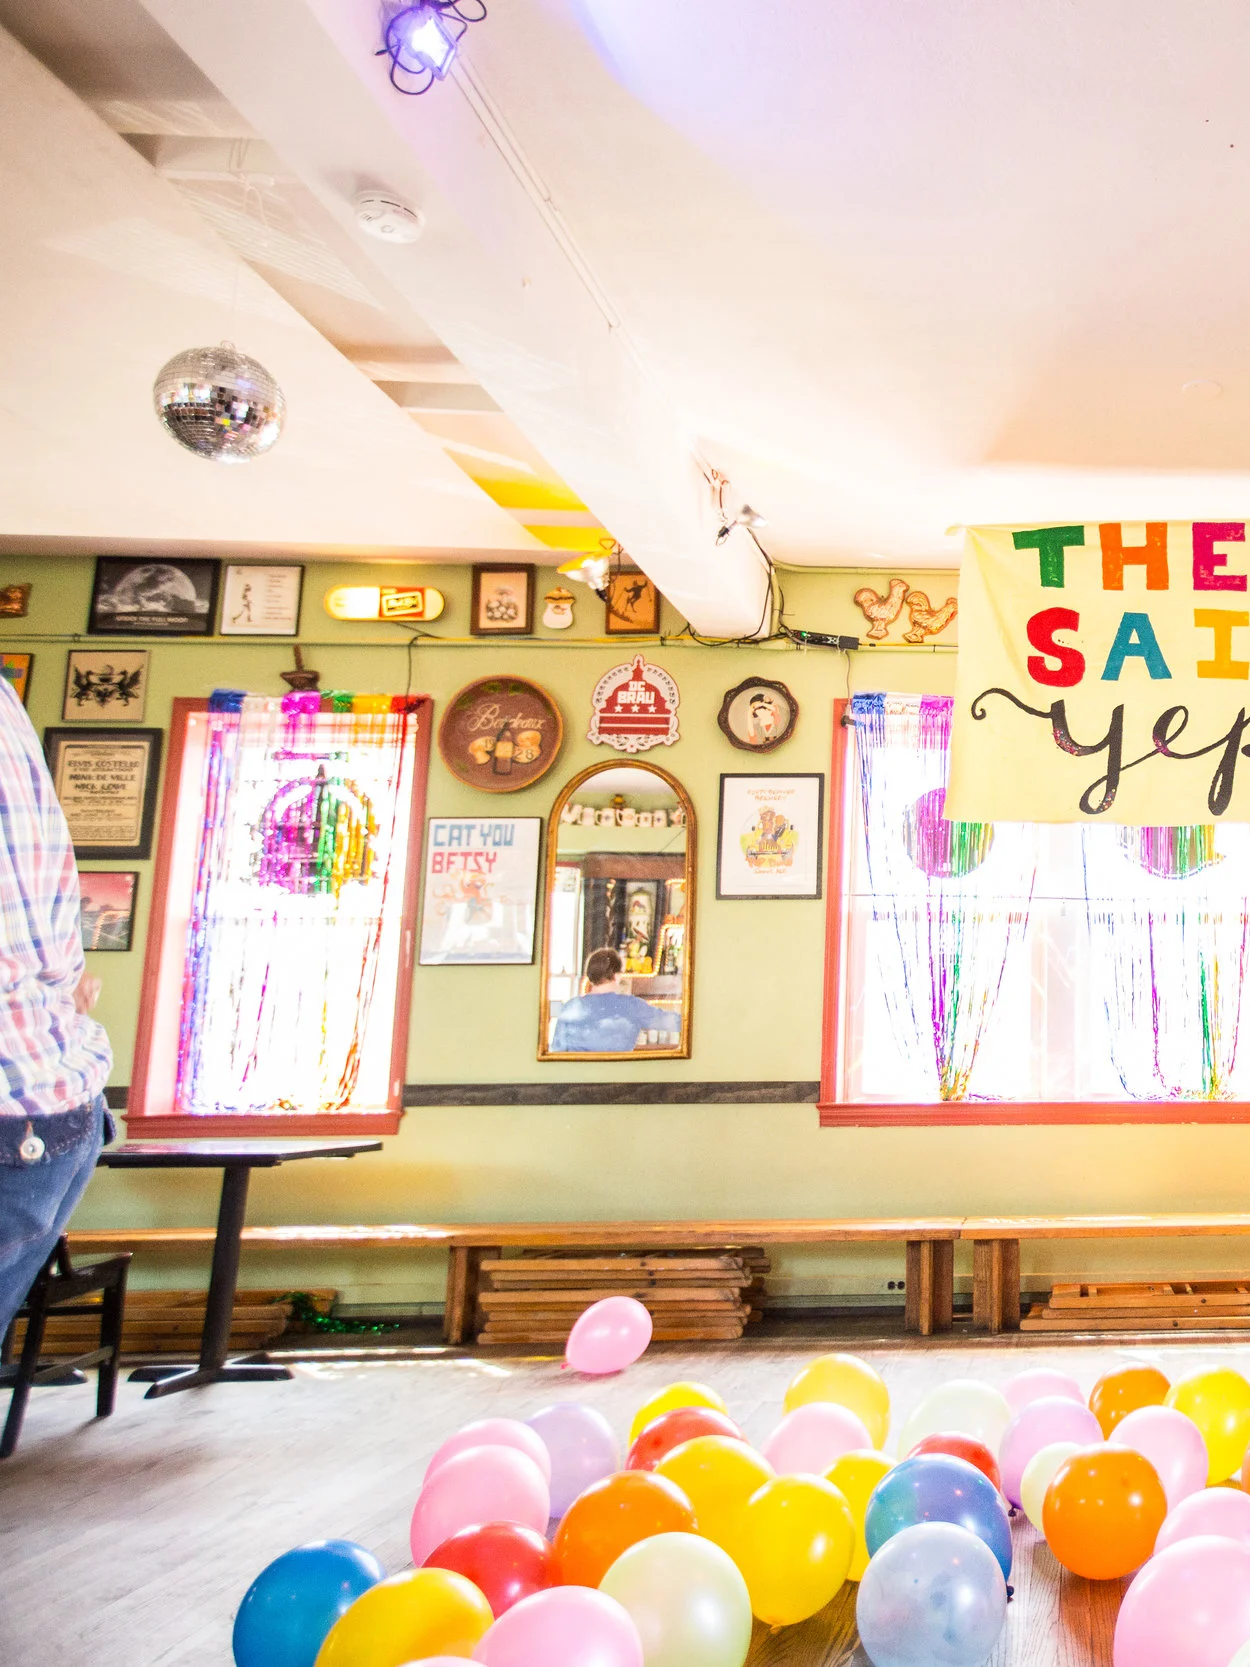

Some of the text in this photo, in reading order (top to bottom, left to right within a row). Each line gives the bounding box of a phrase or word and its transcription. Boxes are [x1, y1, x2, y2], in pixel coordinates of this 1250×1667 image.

[629, 681, 646, 691] DC
[433, 824, 515, 847] CAT YOU
